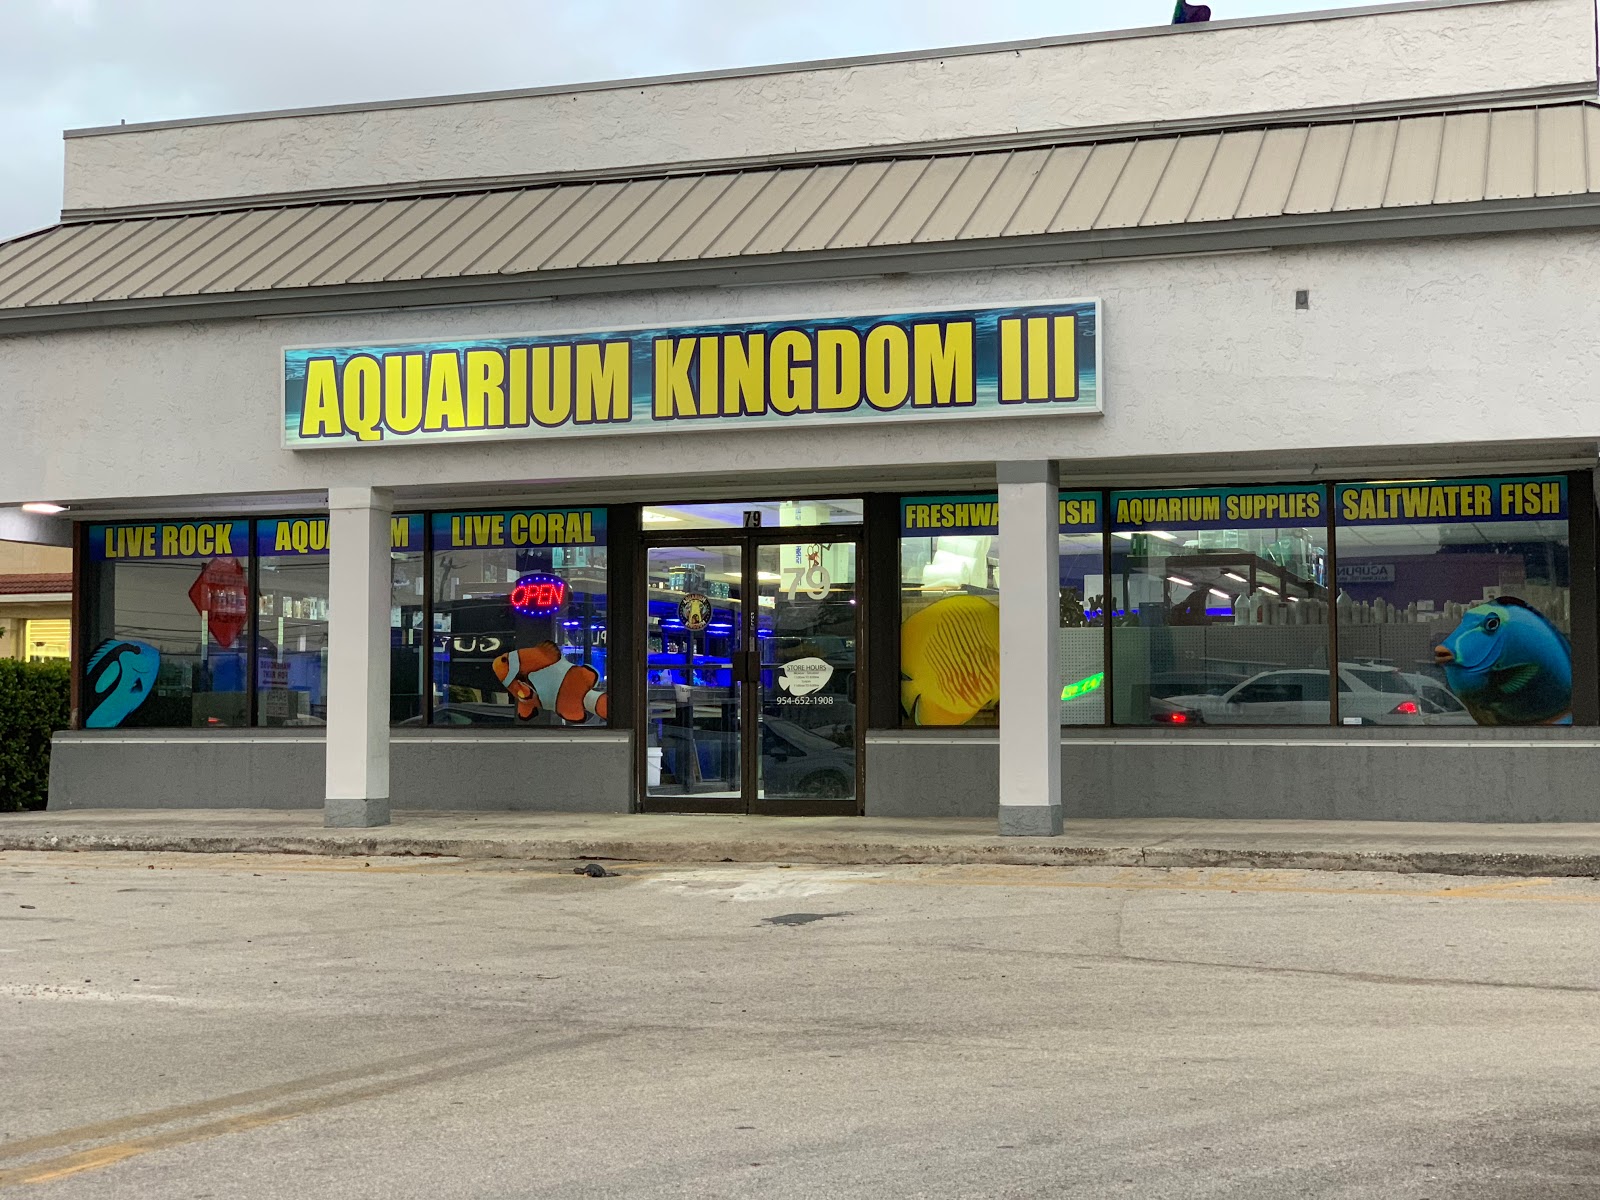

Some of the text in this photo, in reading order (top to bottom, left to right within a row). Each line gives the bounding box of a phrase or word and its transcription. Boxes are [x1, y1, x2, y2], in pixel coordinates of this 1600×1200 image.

[300, 313, 1079, 442] AQUARIUM KINGDOM III
[905, 500, 1096, 529] FRESHWA ISH
[1116, 492, 1320, 526] AQUARIUM SUPPLIES
[1341, 481, 1560, 521] SALTWATER FISH
[274, 517, 409, 554] AQUM
[451, 511, 597, 547] LIVE CORAL
[743, 511, 761, 528] 79
[104, 523, 233, 558] LIVE ROCK
[511, 583, 564, 606] OPEN
[783, 567, 831, 600] 79
[776, 696, 834, 705] 954-652-1908
